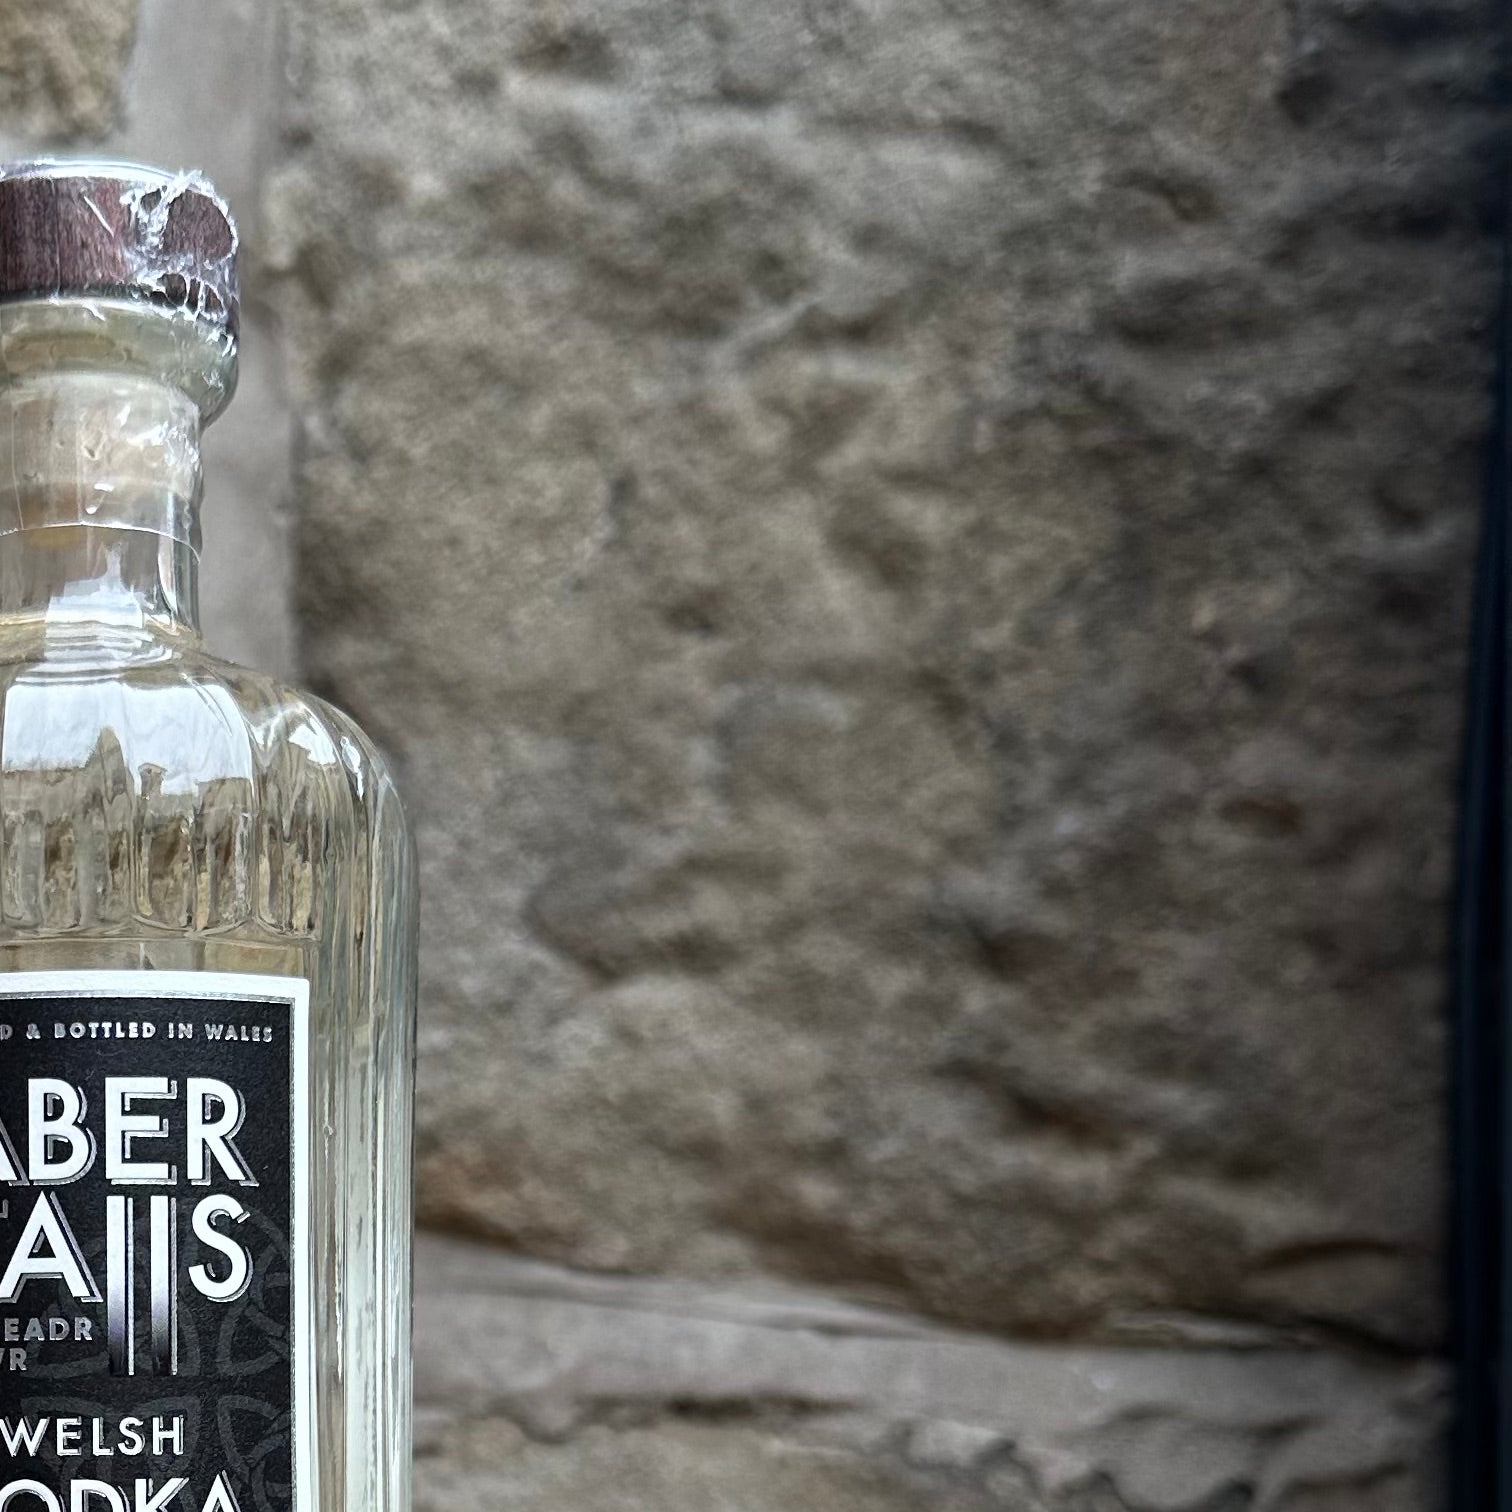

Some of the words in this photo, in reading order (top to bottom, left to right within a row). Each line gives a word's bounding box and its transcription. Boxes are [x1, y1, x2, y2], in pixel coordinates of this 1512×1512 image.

[26, 1023, 41, 1040] &
[54, 1022, 156, 1039] BOTTLED
[168, 1022, 193, 1039] IN
[205, 1023, 273, 1043] WALES
